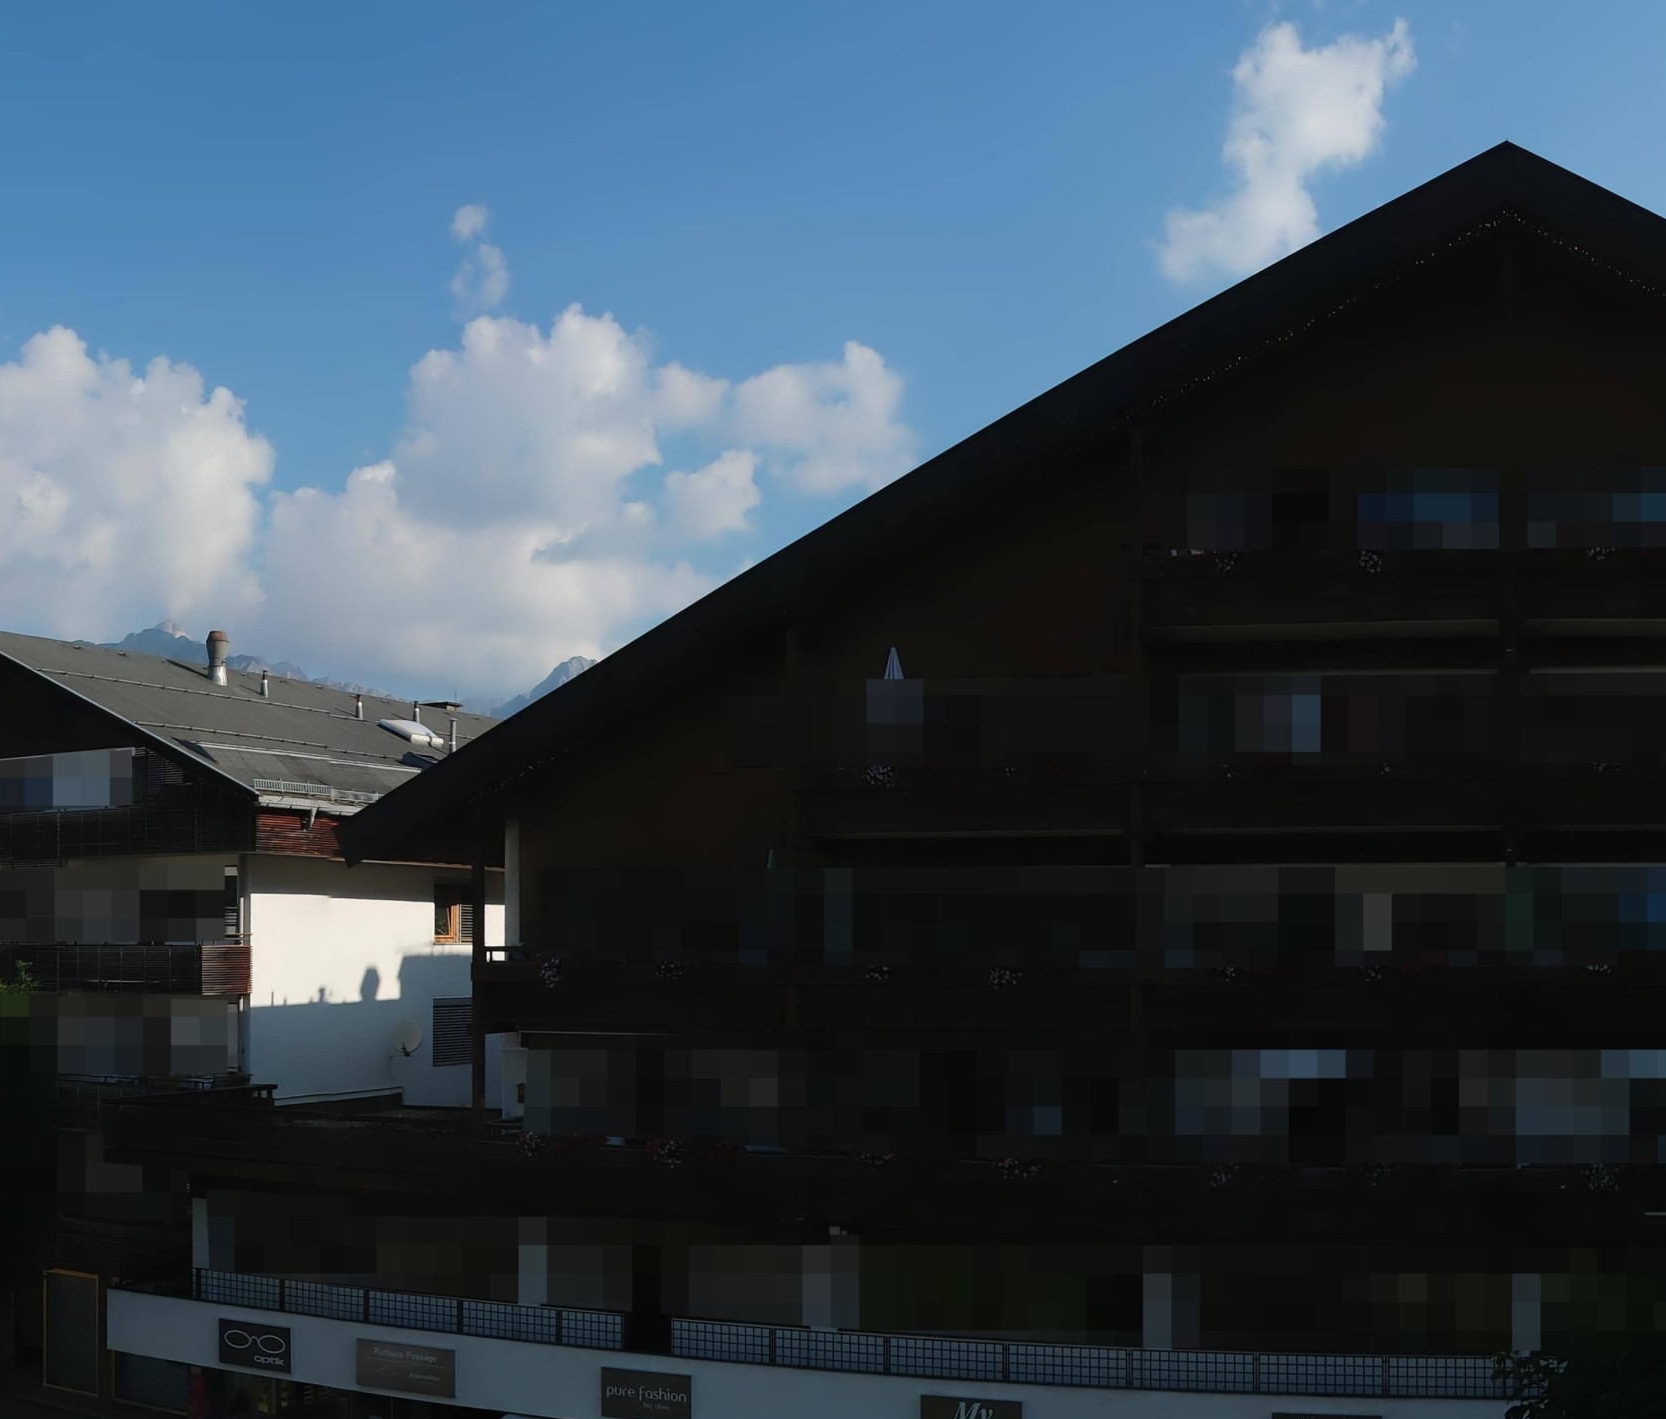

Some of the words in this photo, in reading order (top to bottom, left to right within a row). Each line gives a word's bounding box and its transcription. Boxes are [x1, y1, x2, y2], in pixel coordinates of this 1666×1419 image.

[253, 1355, 285, 1366] optik
[606, 1386, 635, 1398] pure
[639, 1386, 687, 1403] fashion
